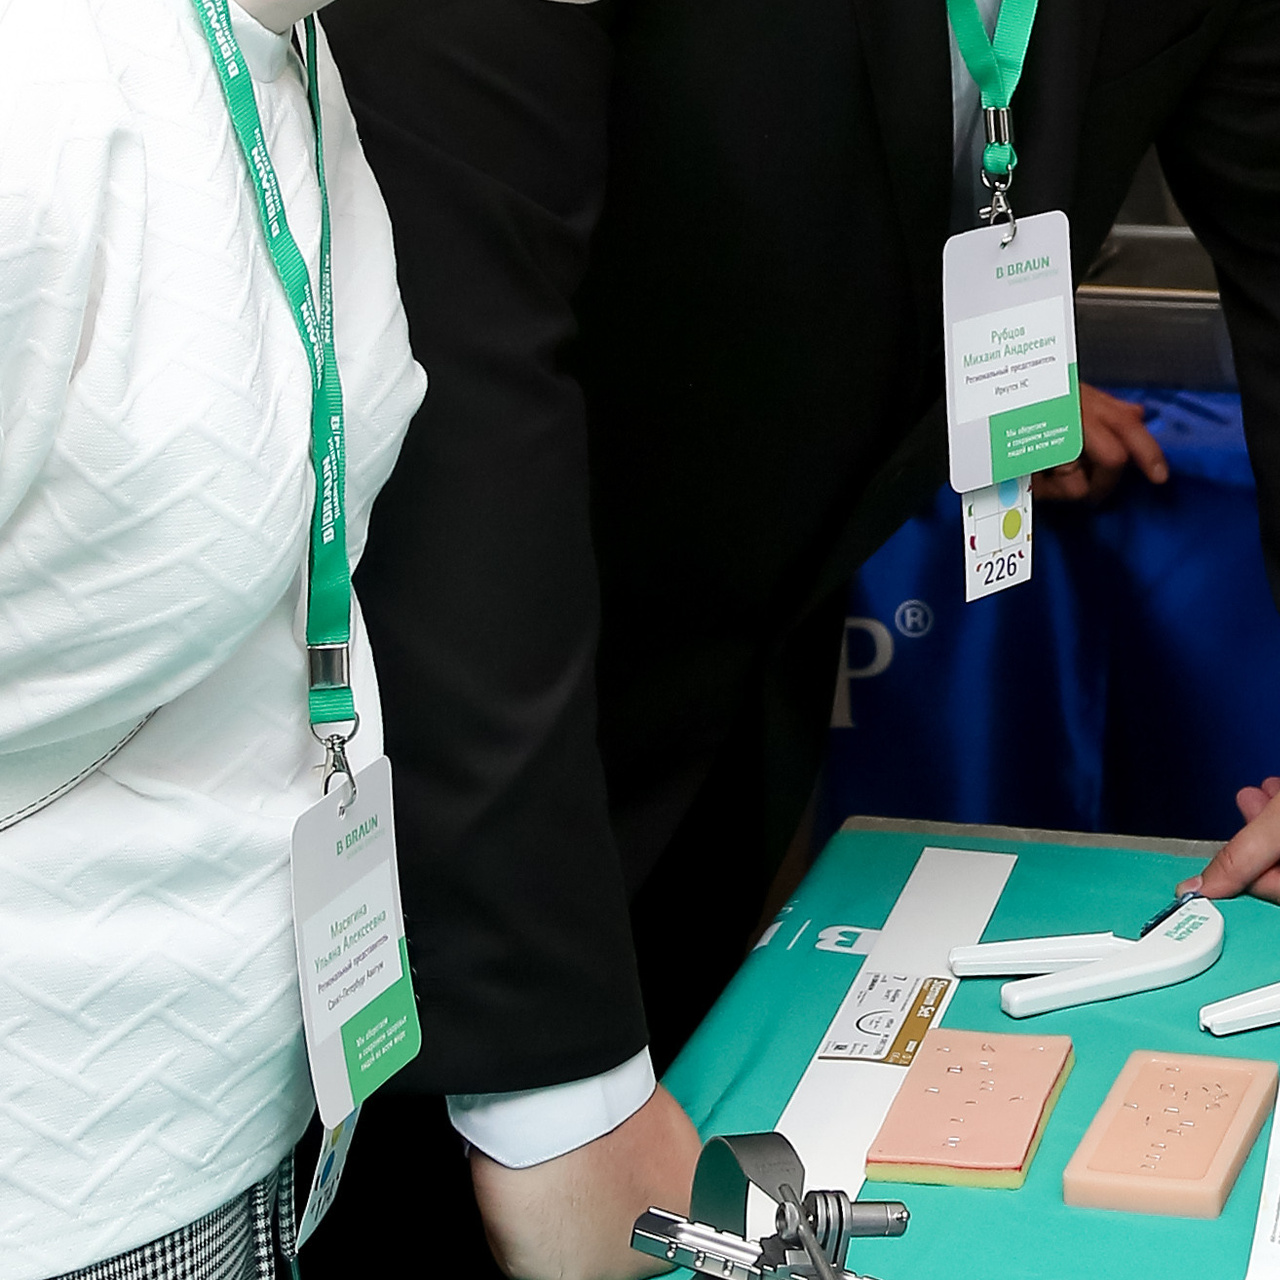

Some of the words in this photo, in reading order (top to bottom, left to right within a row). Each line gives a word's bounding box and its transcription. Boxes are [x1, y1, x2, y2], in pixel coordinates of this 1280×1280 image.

[1007, 256, 1050, 276] BRAUN
[991, 326, 1025, 345] Рубцов
[963, 347, 1001, 367] Михаил
[1004, 336, 1056, 359] Андреевич
[984, 554, 1018, 586] 226
